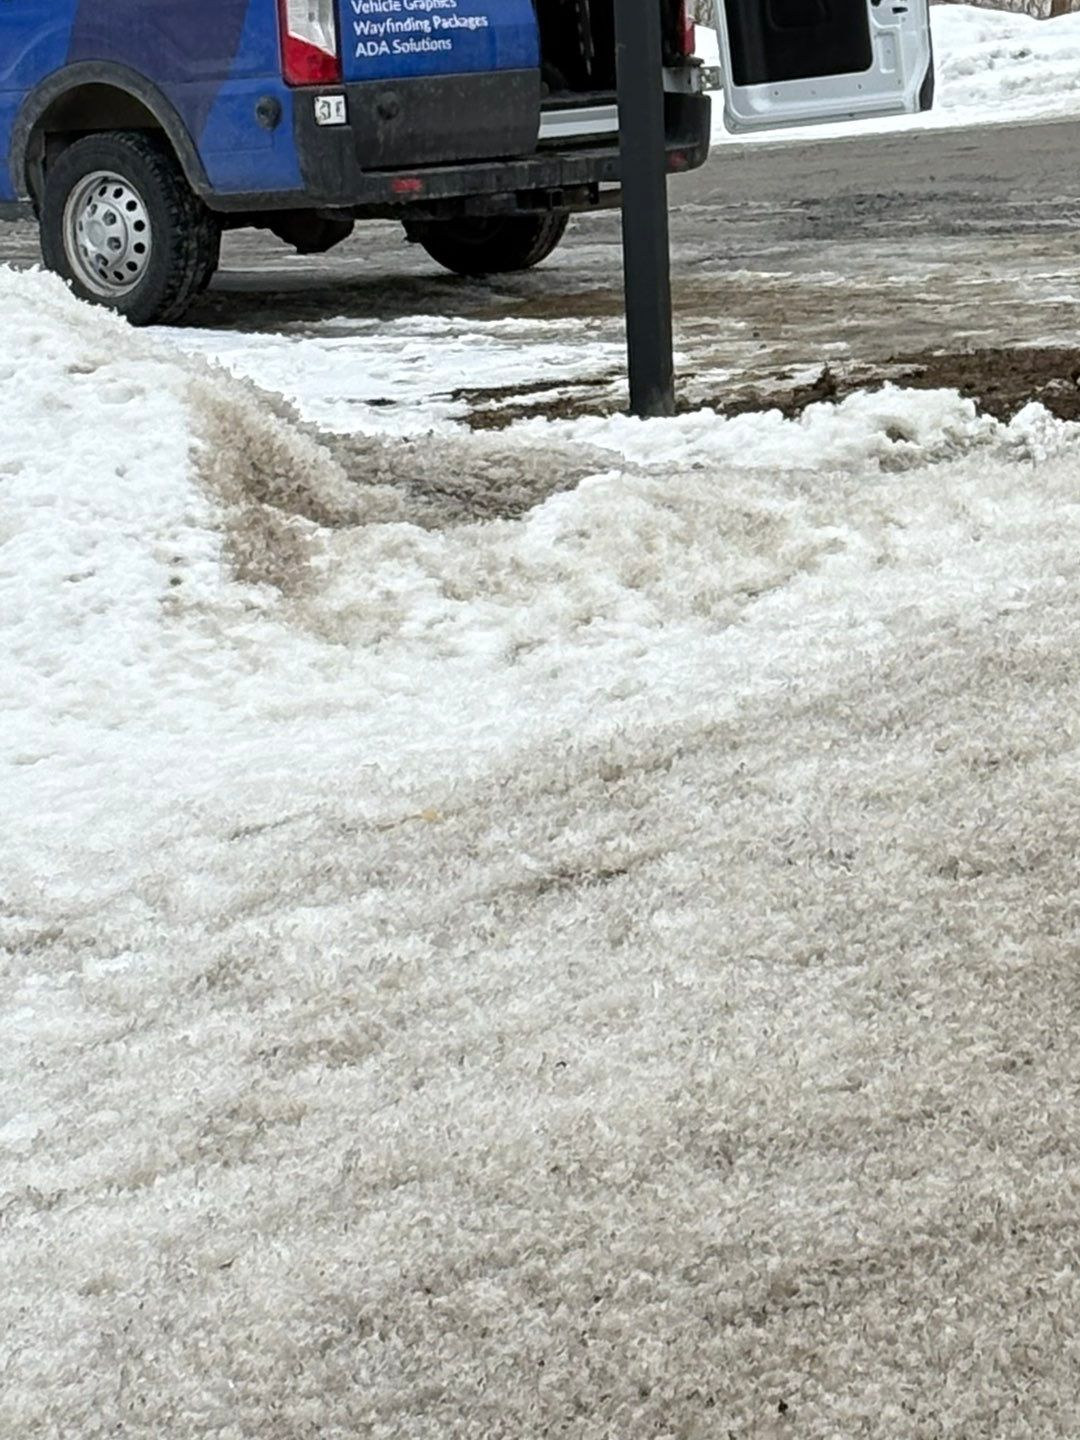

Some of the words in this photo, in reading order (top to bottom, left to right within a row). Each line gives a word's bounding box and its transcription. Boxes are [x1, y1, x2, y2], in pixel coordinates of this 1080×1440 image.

[353, 17, 432, 37] Wayfinding
[433, 14, 488, 31] Packages
[355, 40, 390, 58] ADA
[392, 37, 452, 54] Solutions
